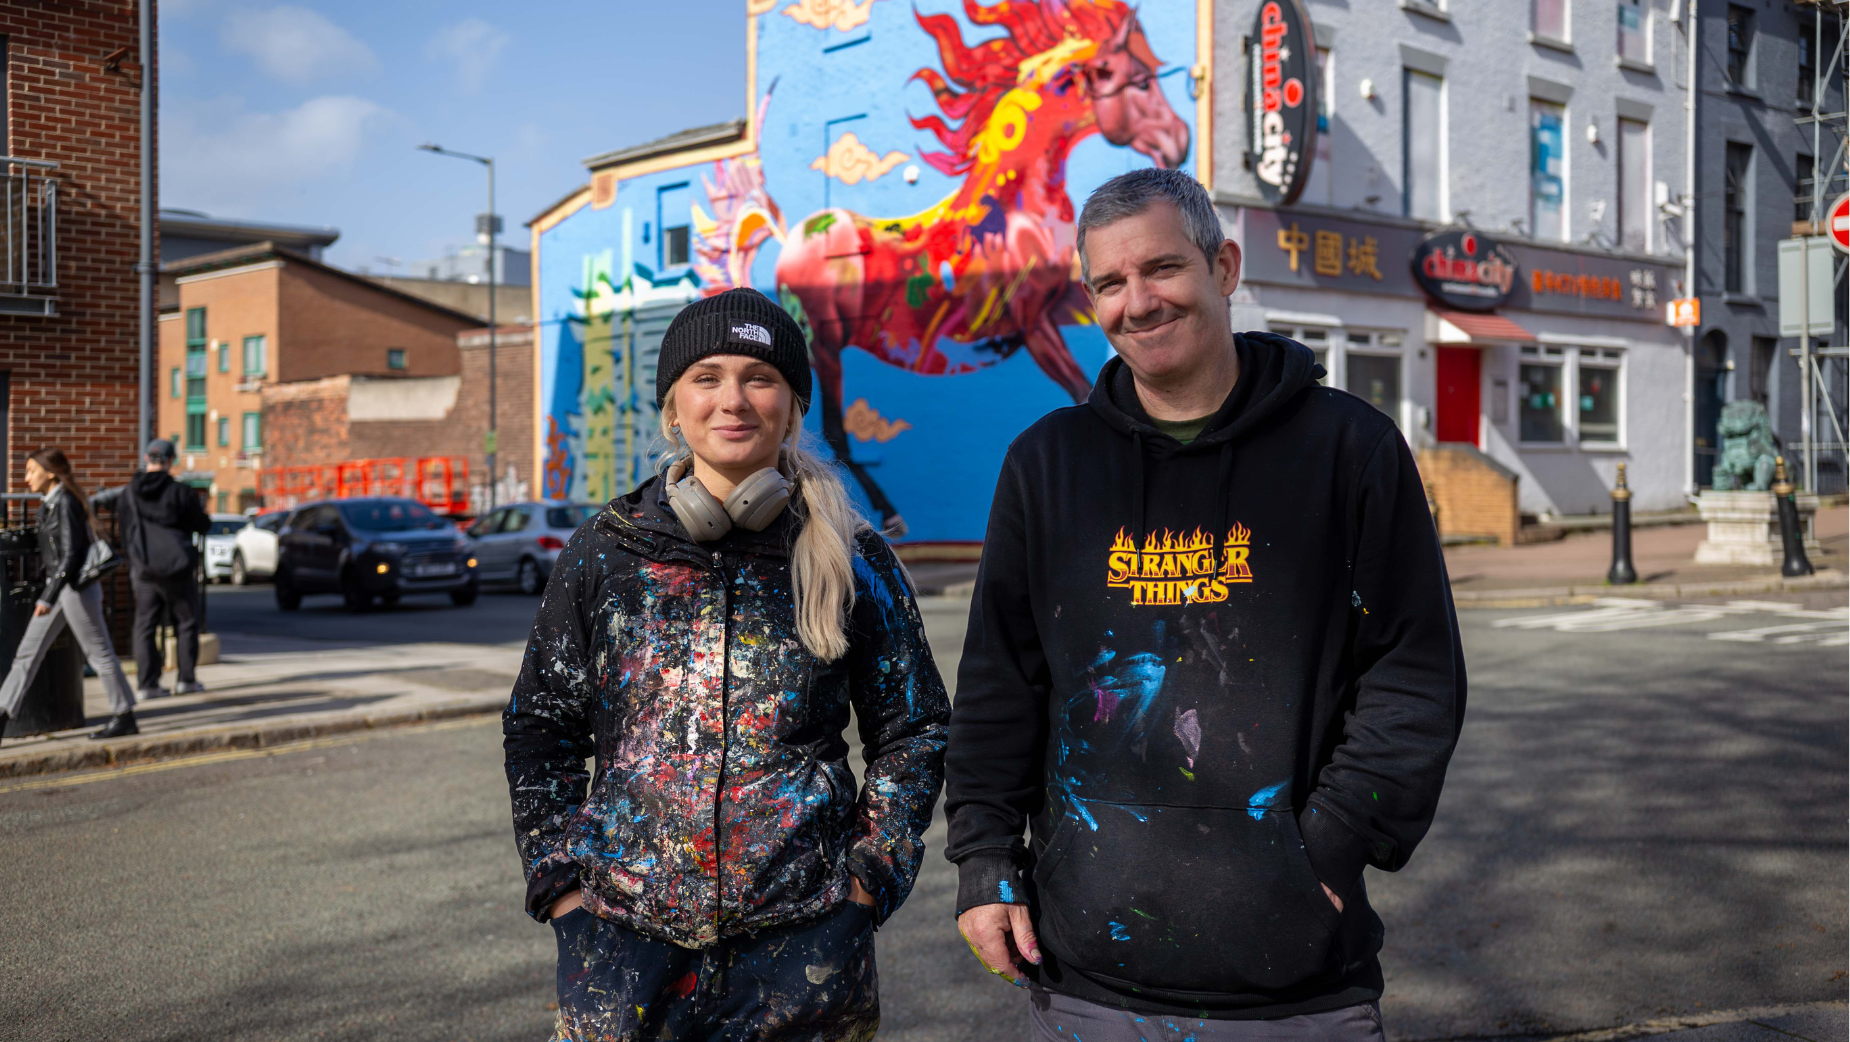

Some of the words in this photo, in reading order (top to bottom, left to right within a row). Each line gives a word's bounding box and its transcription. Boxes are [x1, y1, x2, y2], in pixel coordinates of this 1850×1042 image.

[1277, 222, 1383, 281] 中國城
[732, 327, 759, 336] NORTH
[745, 323, 759, 331] THE
[739, 333, 759, 341] FACE
[1107, 546, 1253, 583] STRANGER
[1128, 576, 1230, 605] THINGS
